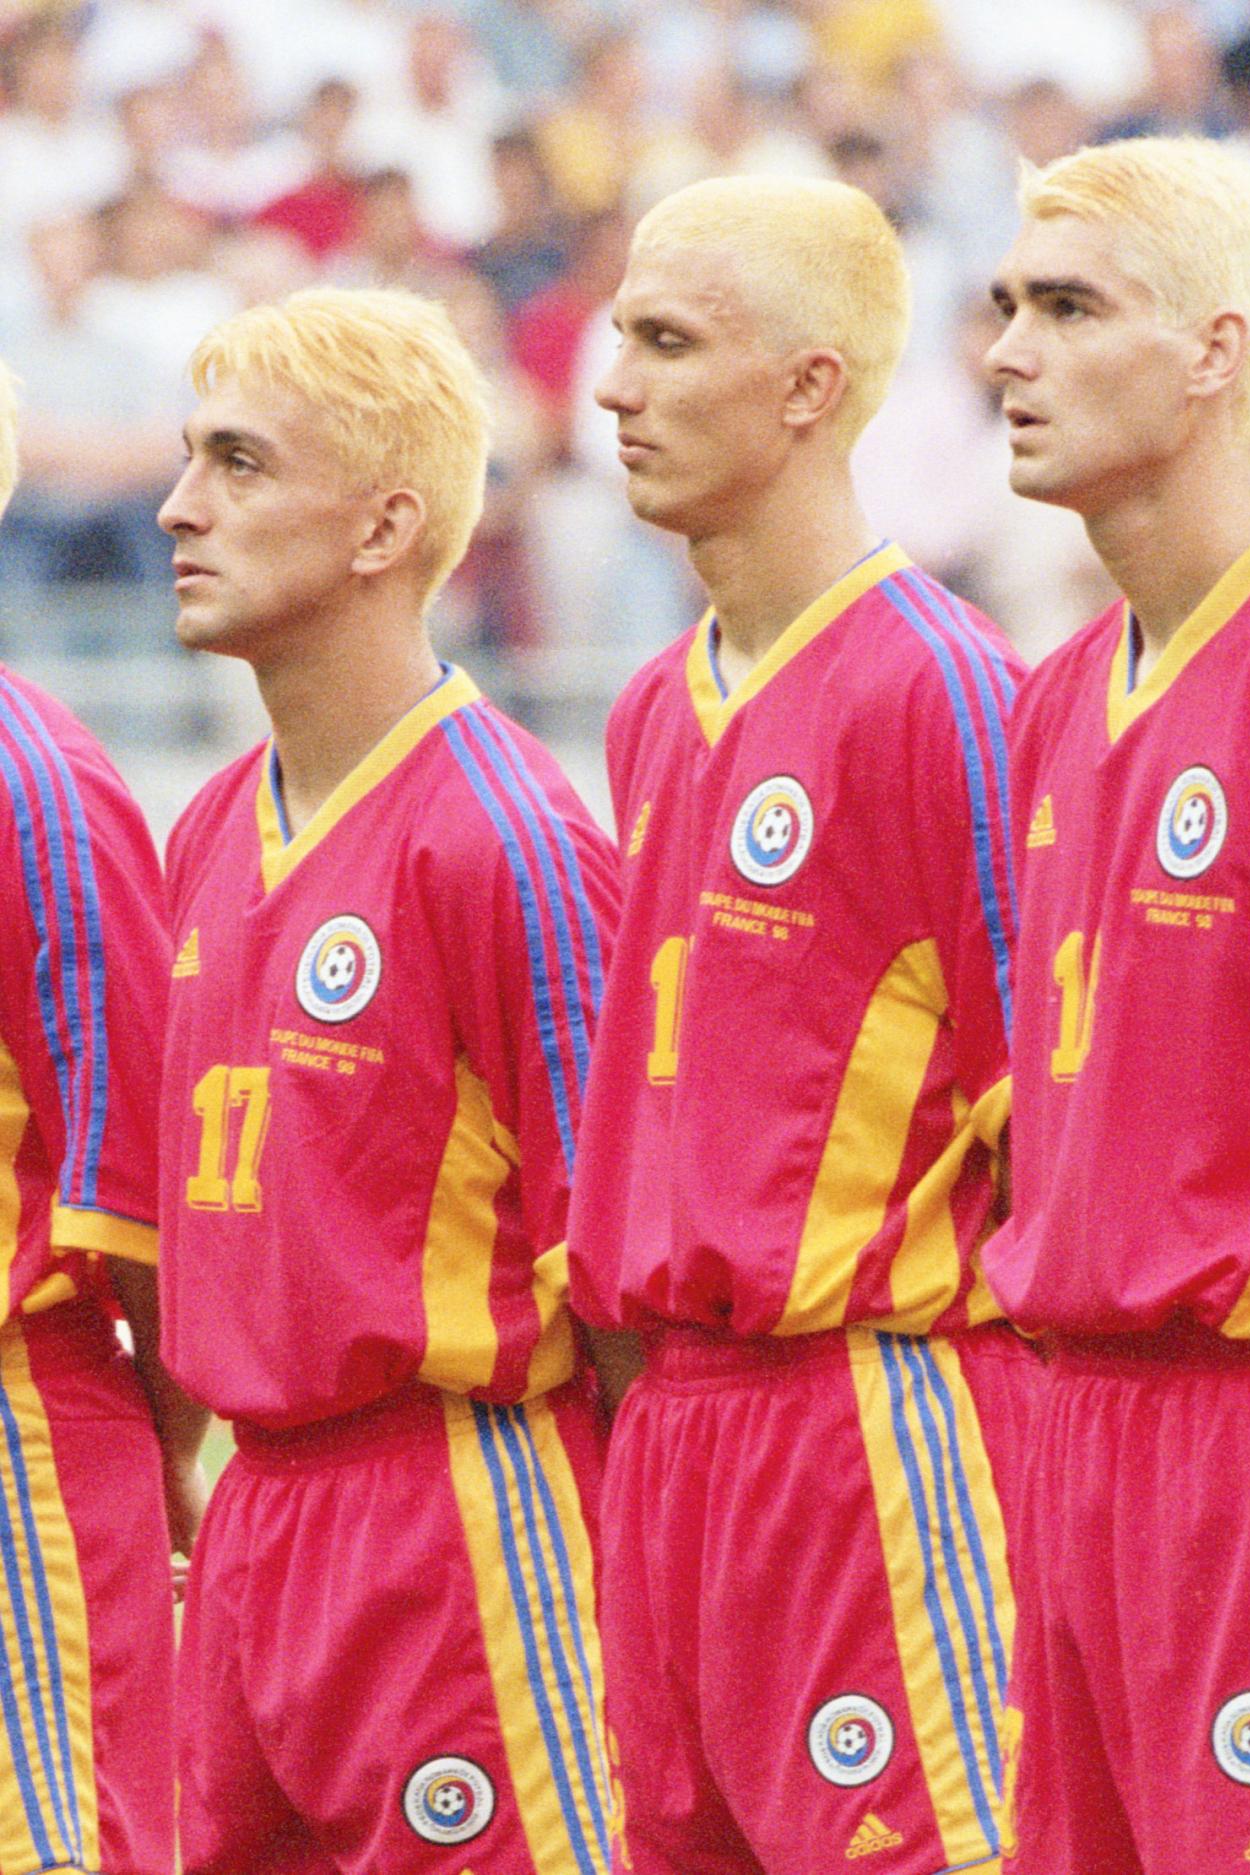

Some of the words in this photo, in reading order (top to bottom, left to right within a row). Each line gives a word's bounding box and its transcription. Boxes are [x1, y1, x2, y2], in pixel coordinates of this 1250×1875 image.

[713, 911, 767, 936] FRANCE
[647, 935, 696, 1086] 1
[281, 1047, 331, 1071] FRANCE
[186, 1064, 271, 1213] 17
[845, 1832, 903, 1860] adidas
